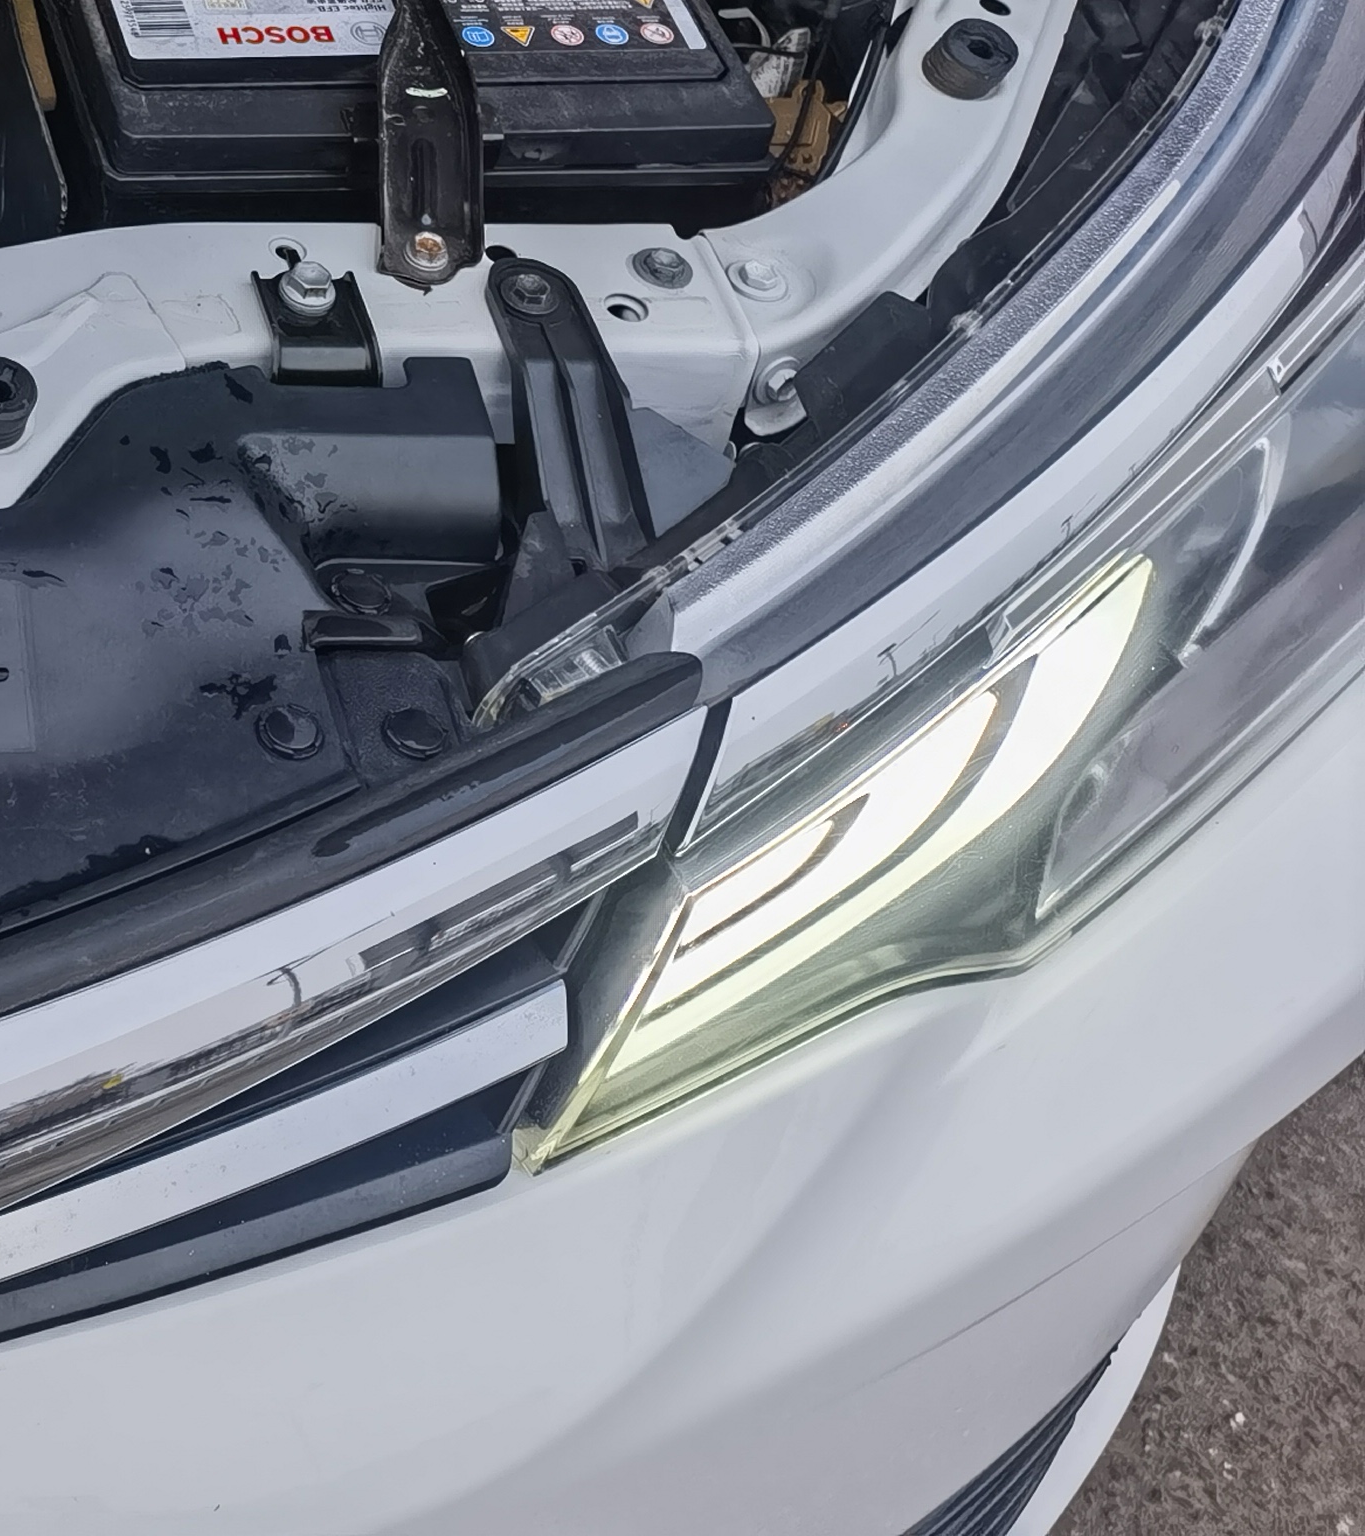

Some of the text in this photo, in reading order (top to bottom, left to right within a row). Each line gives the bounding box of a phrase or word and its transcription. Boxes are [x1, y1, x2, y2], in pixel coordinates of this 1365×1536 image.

[317, 3, 387, 13] Hightec EFB
[217, 25, 335, 45] BOSCH
